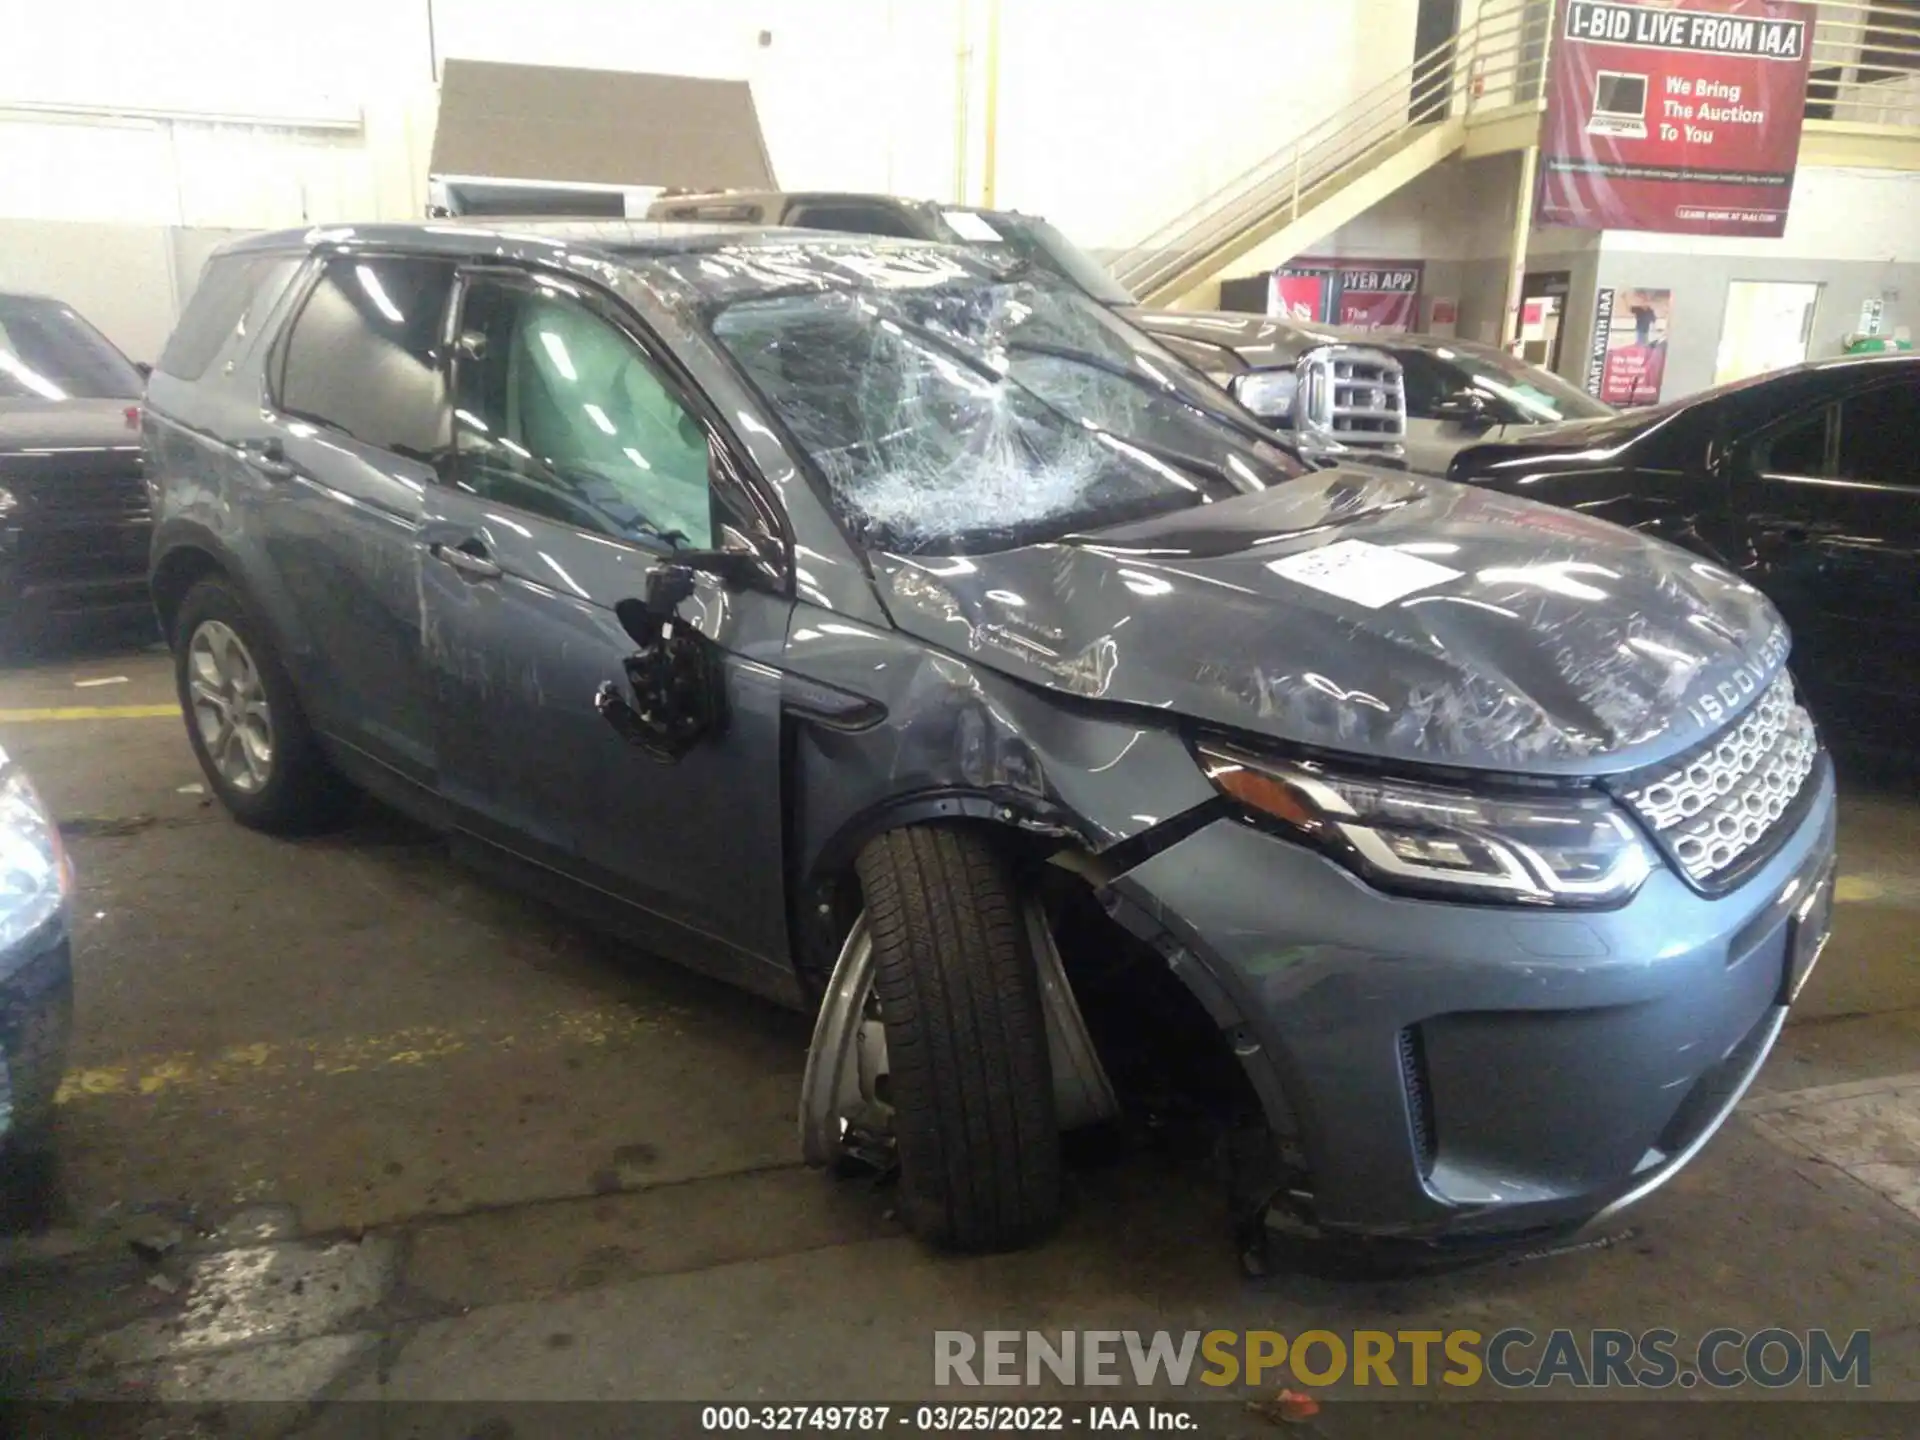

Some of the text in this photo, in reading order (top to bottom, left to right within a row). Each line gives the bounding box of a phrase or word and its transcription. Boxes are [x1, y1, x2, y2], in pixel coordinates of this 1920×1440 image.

[1573, 5, 1797, 54] I-BID LIVE FROM IAA
[1666, 76, 1741, 103] We Bring
[1663, 100, 1764, 123] The Auction
[1660, 122, 1714, 144] To You
[1381, 272, 1412, 289] APP
[1587, 360, 1603, 397] MART
[1598, 291, 1613, 316] IAA
